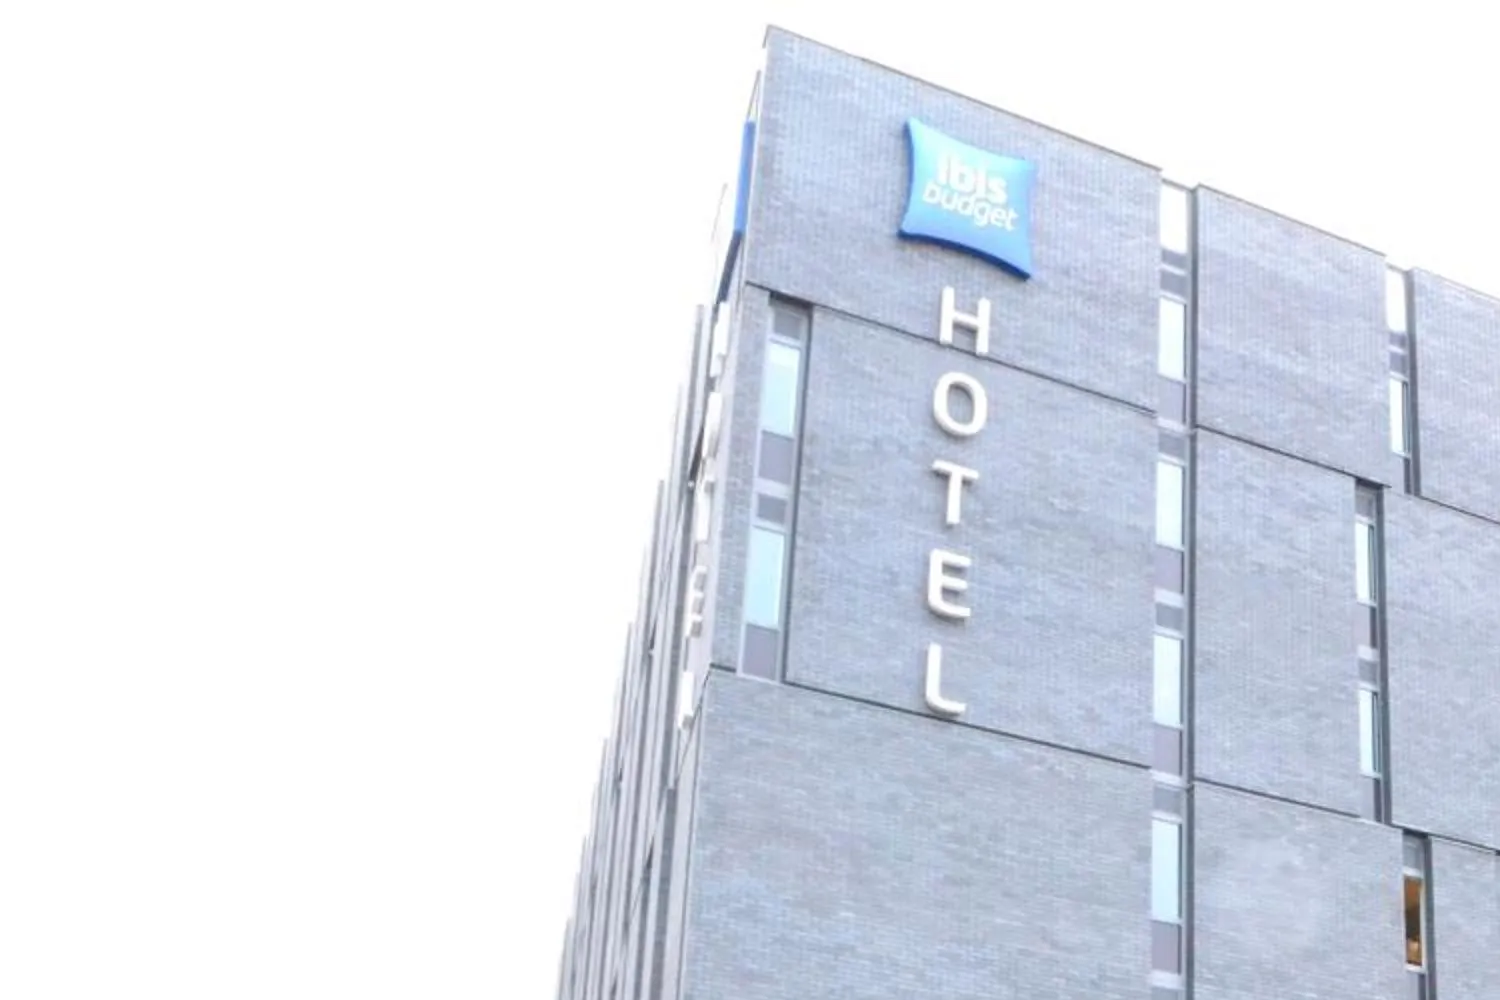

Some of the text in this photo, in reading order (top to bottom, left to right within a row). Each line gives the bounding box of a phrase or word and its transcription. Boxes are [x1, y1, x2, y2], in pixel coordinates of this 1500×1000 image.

[936, 152, 1008, 205] ibis
[922, 179, 1019, 232] budget
[924, 285, 991, 718] HOTEL
